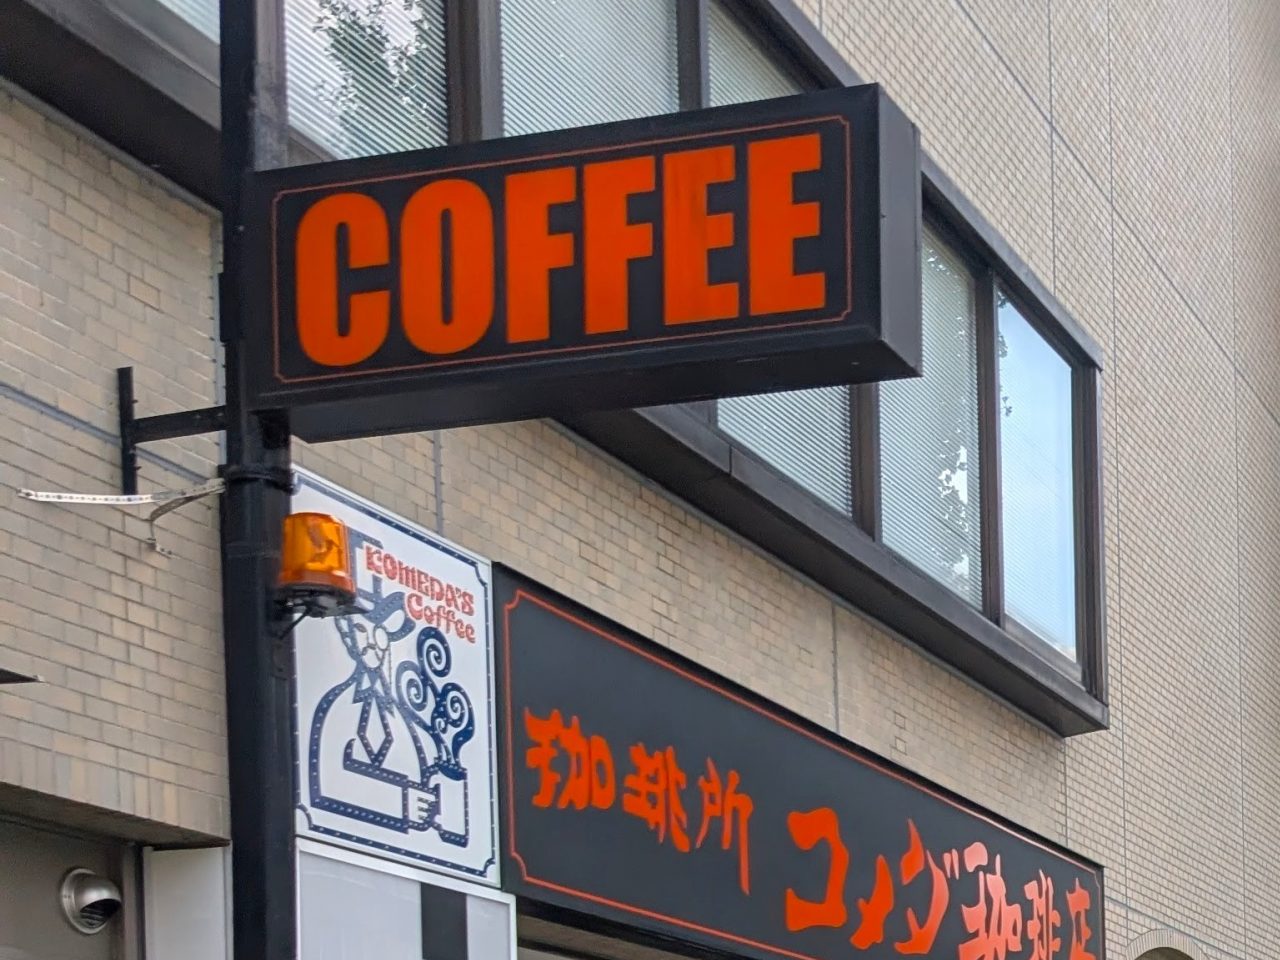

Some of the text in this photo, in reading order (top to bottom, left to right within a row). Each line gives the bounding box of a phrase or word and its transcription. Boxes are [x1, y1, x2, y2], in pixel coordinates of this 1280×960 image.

[295, 133, 826, 367] COFFEE
[365, 544, 475, 618] KOMEDA'S
[406, 591, 476, 645] Coffee
[525, 706, 754, 895] 珈琲所
